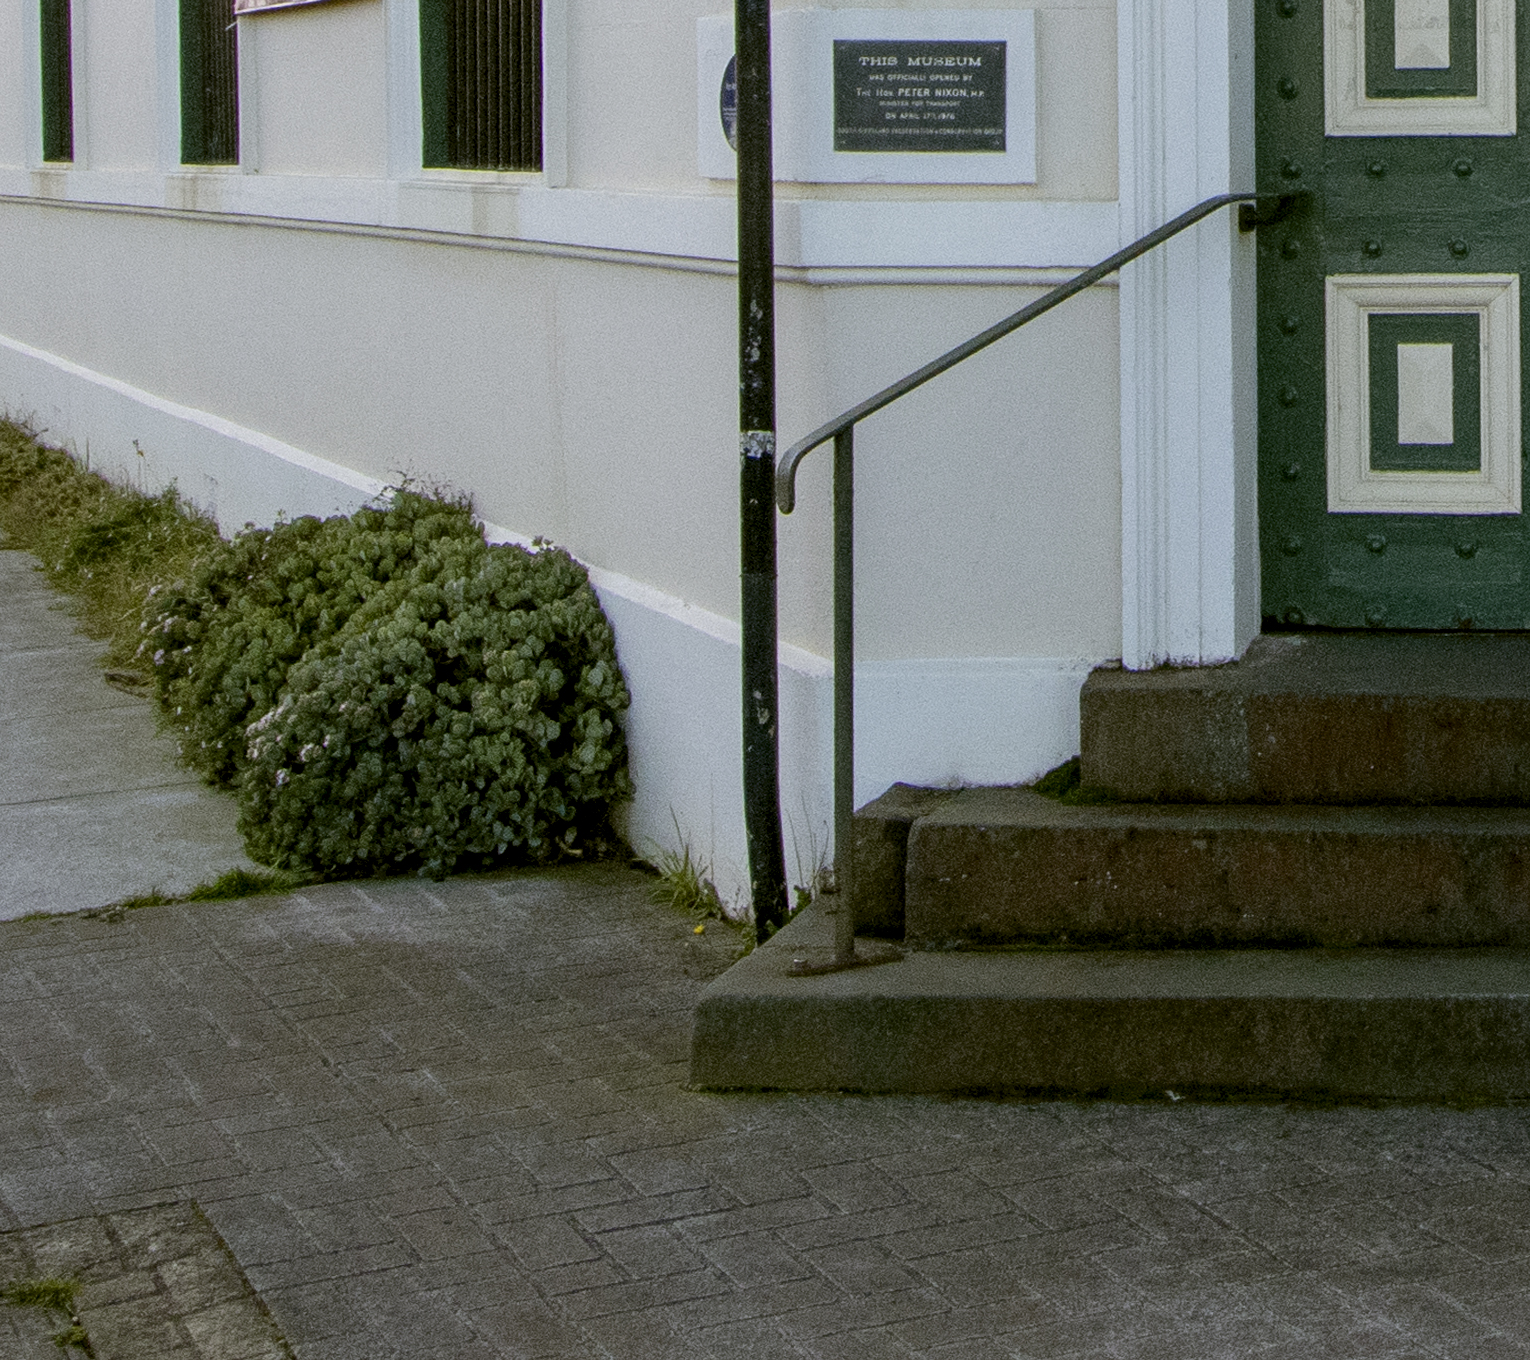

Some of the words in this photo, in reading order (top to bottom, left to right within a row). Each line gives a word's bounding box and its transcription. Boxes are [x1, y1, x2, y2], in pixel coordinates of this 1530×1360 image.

[858, 56, 898, 67] THIS
[907, 56, 982, 67] MUSEUM
[963, 74, 973, 82] BY
[897, 87, 930, 97] PETER
[885, 112, 896, 120] ON
